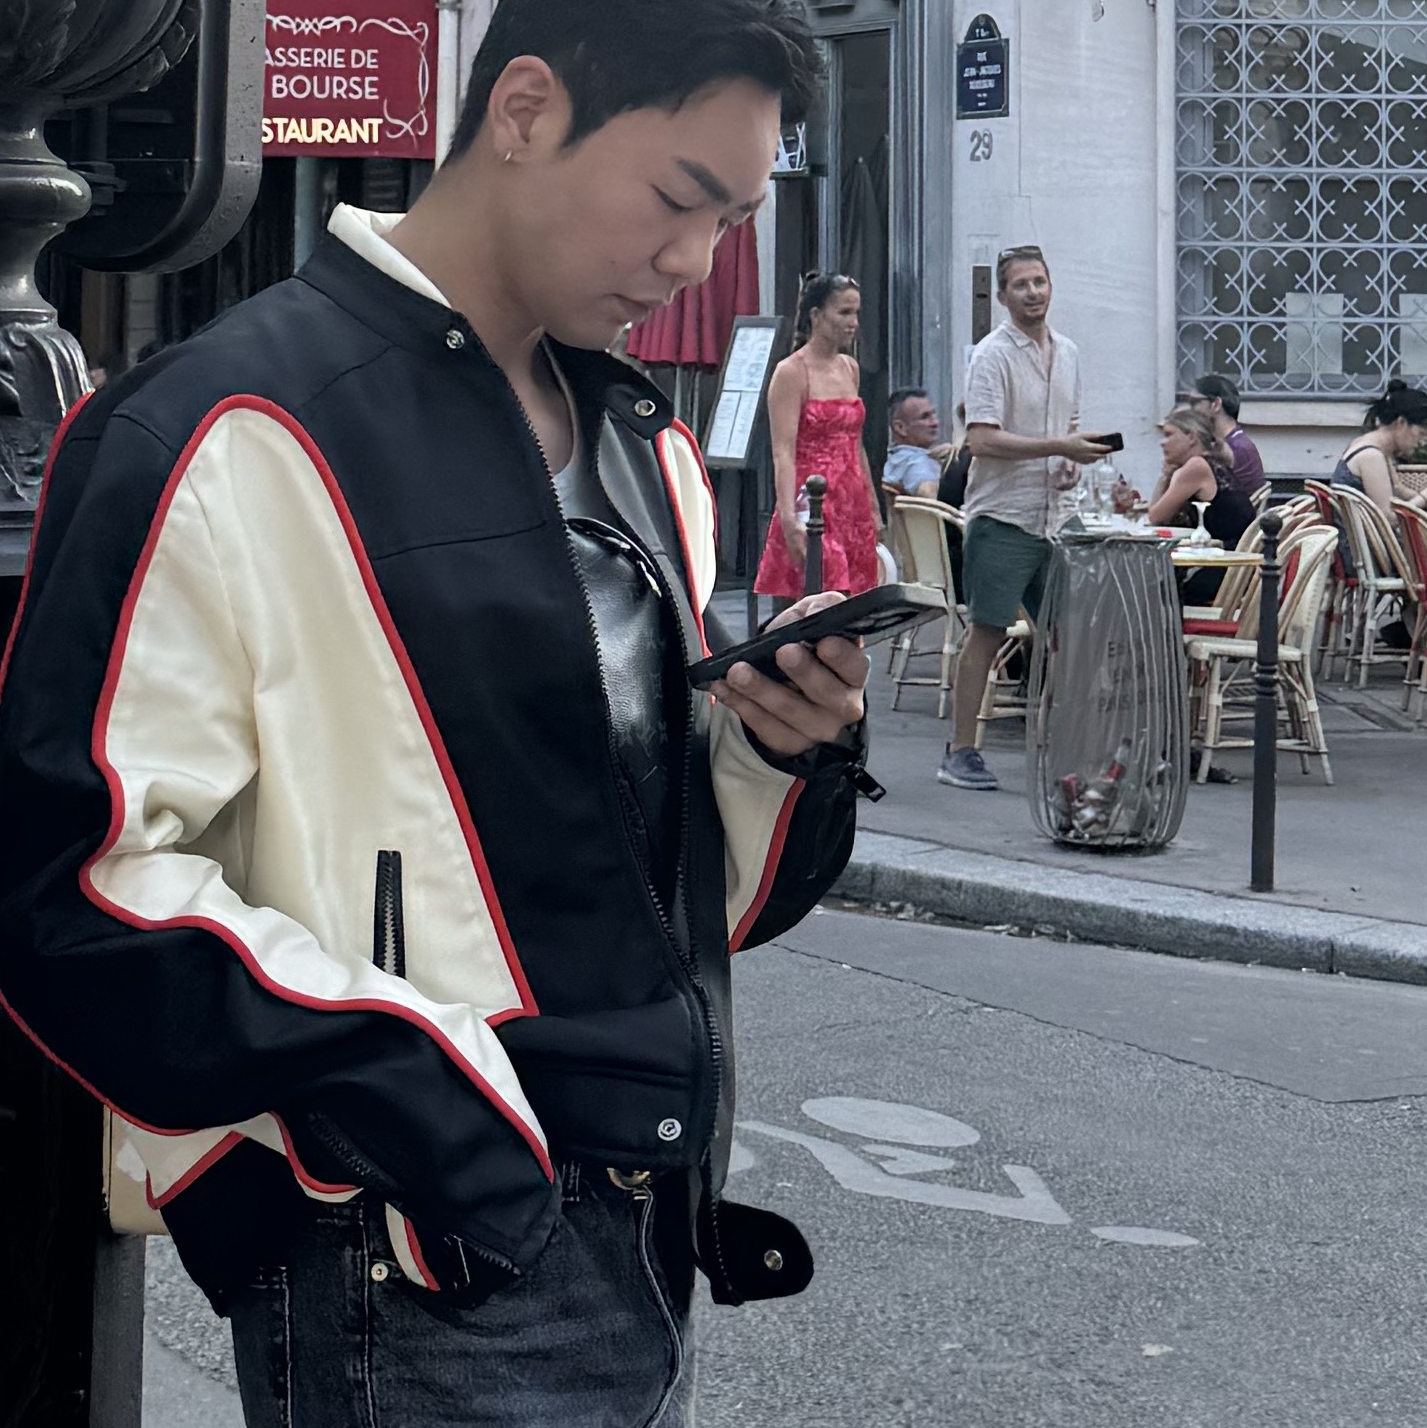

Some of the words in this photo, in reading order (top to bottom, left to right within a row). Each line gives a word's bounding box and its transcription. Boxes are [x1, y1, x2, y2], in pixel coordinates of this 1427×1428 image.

[350, 48, 379, 69] DE
[272, 74, 380, 100] BOURSE
[261, 117, 384, 144] STAURANT
[969, 128, 993, 162] 29
